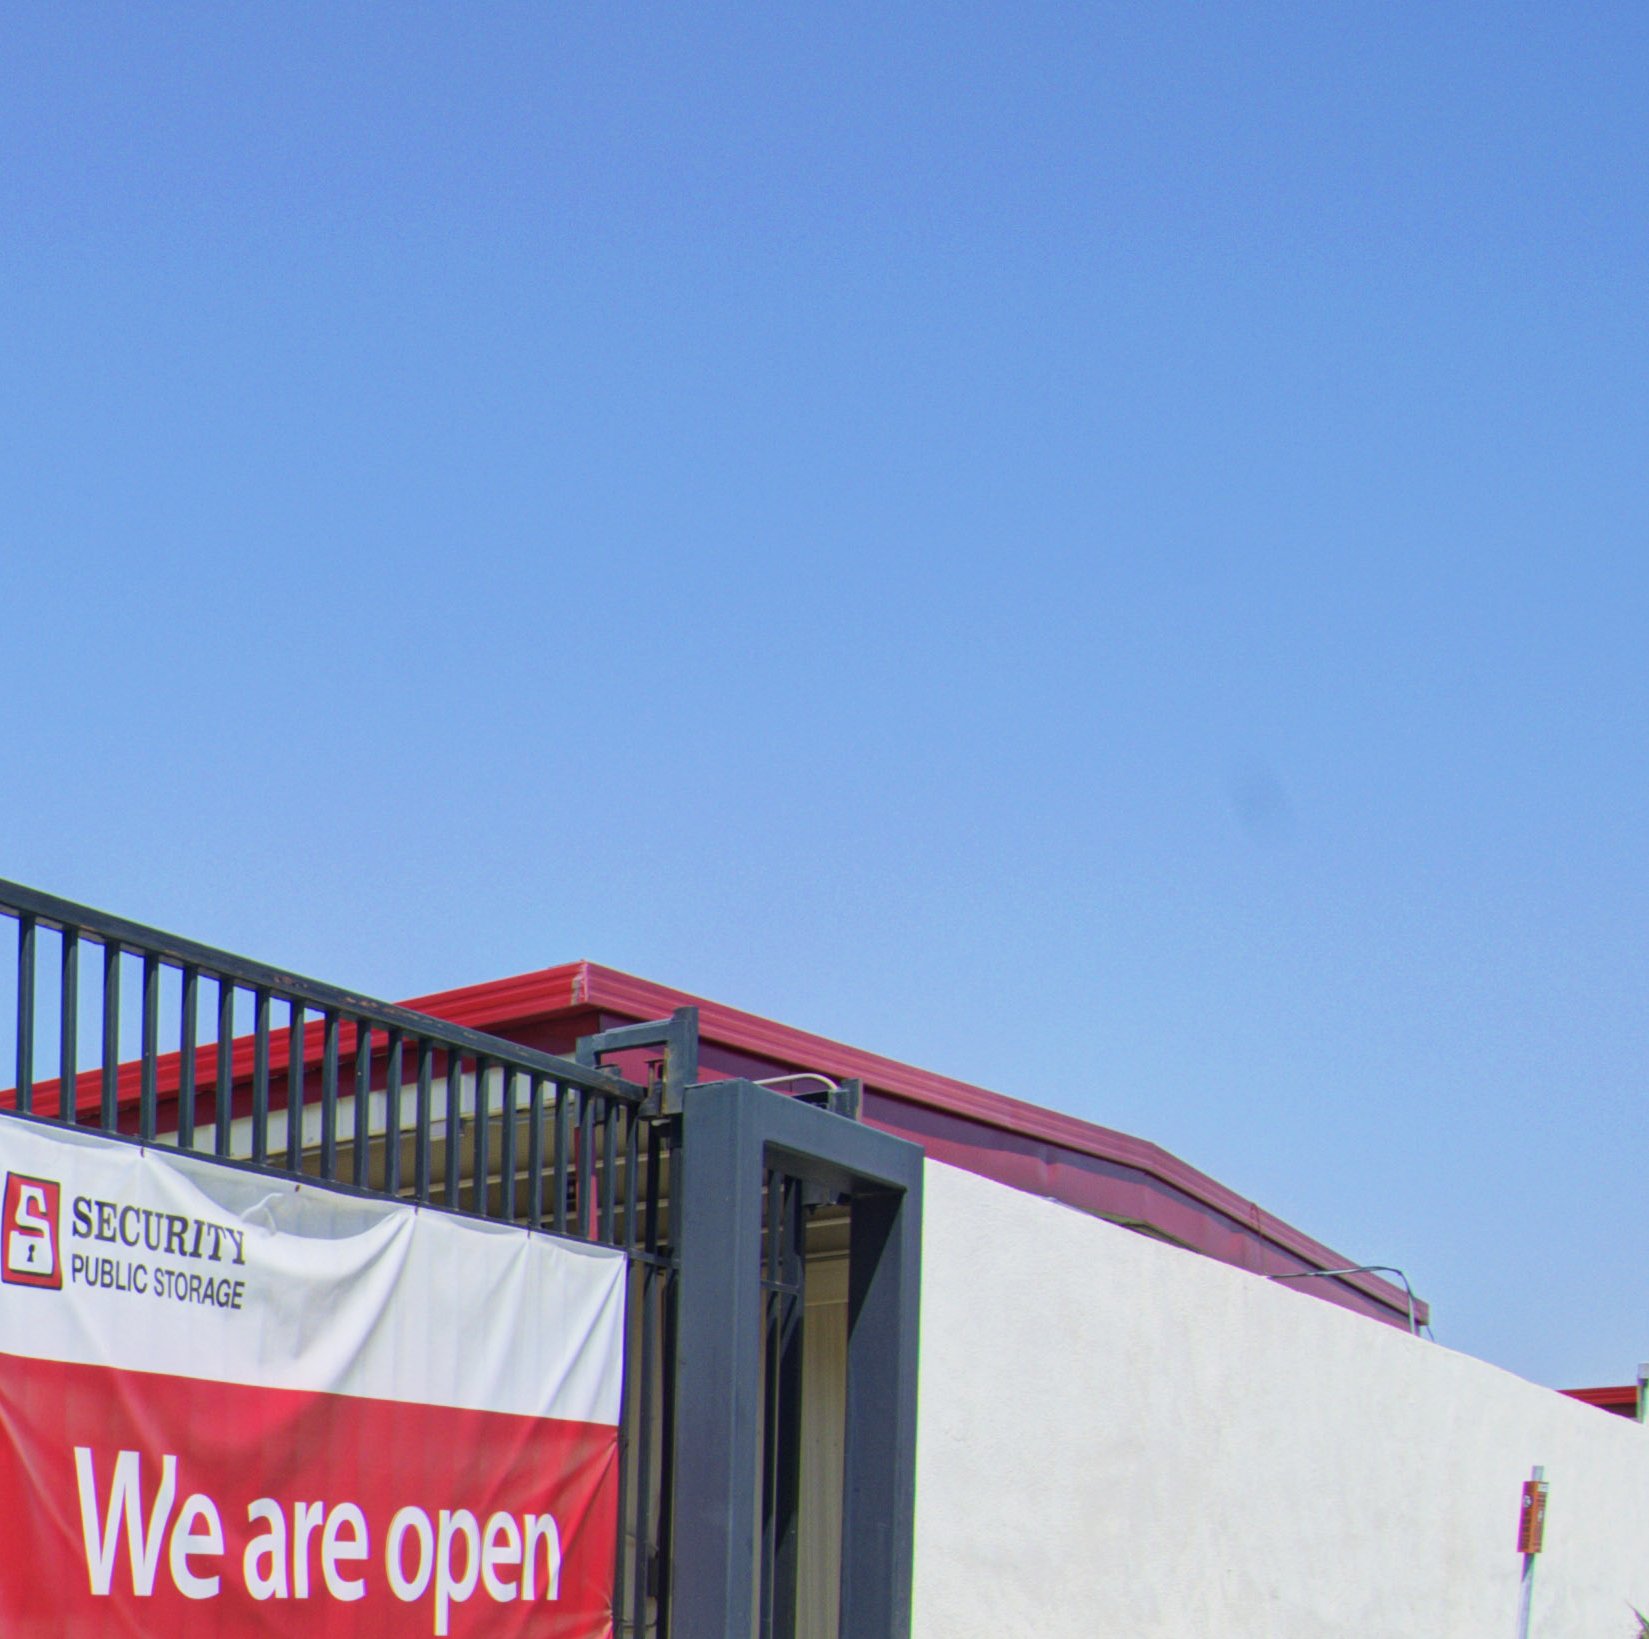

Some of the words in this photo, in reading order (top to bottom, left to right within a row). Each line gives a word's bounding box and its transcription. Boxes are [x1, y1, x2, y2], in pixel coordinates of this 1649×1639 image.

[72, 1196, 246, 1265] SECURITY
[72, 1254, 147, 1294] PUBLIC
[154, 1268, 246, 1309] STORAGE
[75, 1447, 224, 1599] We
[245, 1498, 367, 1601] are
[388, 1506, 560, 1636] open
